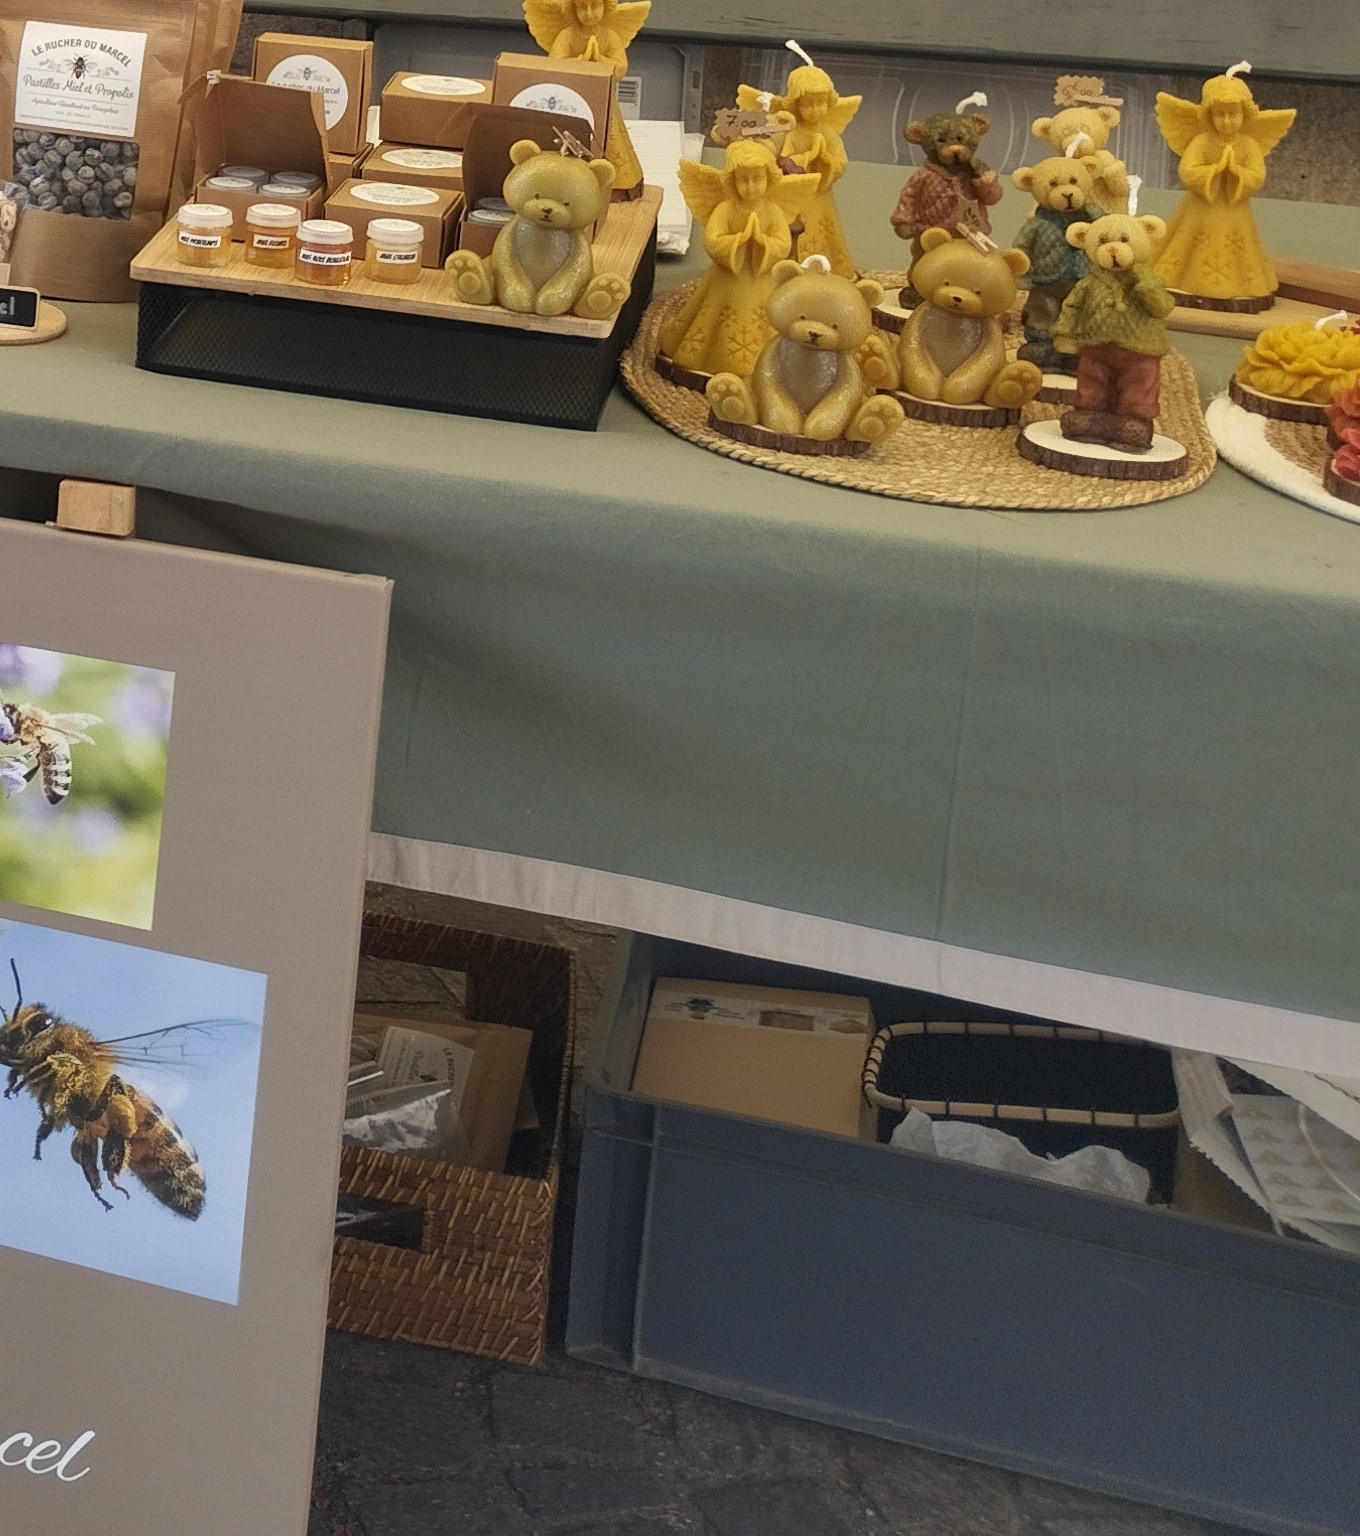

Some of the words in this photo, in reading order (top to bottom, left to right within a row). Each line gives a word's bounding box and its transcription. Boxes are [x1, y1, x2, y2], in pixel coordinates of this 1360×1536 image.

[32, 46, 43, 56] LE
[45, 39, 81, 51] RUCHER
[85, 40, 97, 49] DU
[99, 44, 131, 68] MARCEL
[23, 74, 60, 89] Pastilles
[62, 80, 83, 93] Miel
[84, 85, 92, 94] et
[95, 84, 134, 101] Propolis
